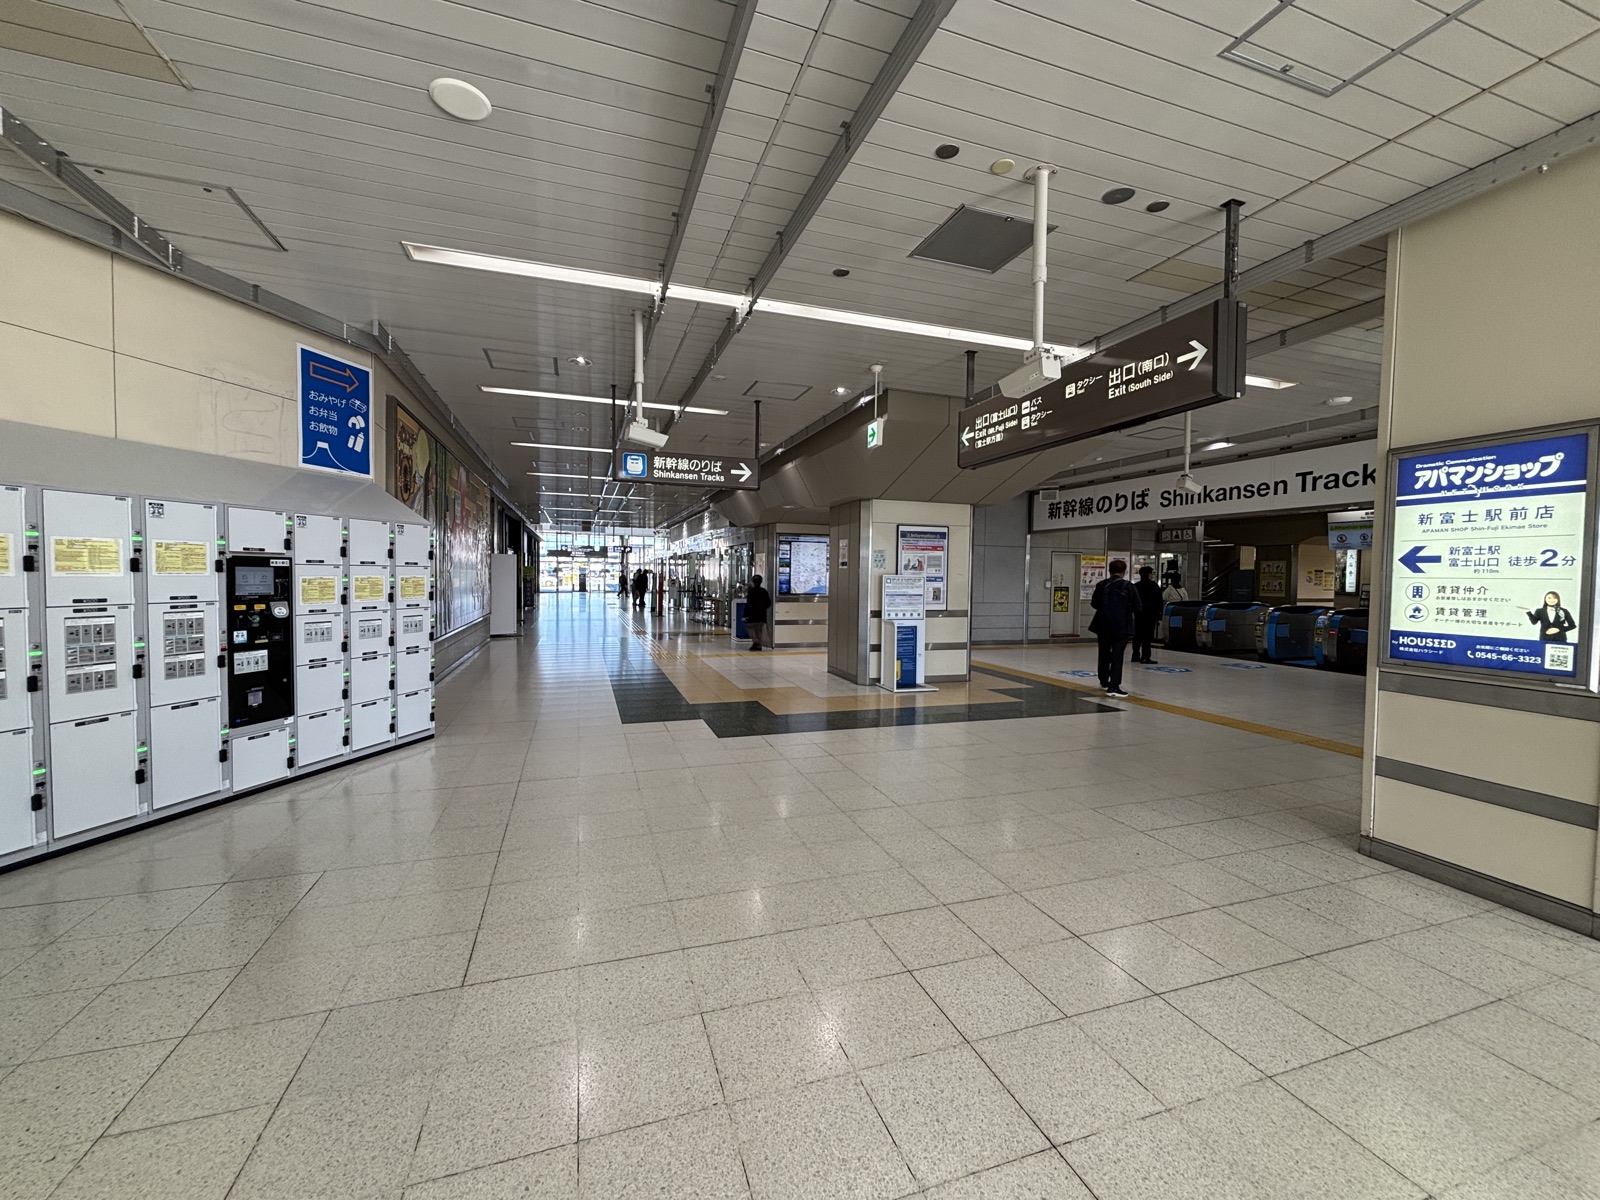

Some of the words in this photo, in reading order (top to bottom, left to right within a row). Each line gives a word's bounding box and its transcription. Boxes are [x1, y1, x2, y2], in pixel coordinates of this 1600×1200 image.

[1108, 352, 1170, 387] 出口(南口)
[1076, 375, 1103, 389] タクシー
[1108, 385, 1127, 399] Exit
[1128, 378, 1152, 393] (South
[1153, 370, 1174, 385] Side)
[308, 390, 346, 408] おみやげ
[1031, 396, 1042, 406] バス
[308, 406, 338, 421] お弁当
[1031, 410, 1053, 421] タクシー
[309, 420, 338, 436] お飲物
[975, 428, 987, 440] Exit
[653, 456, 722, 472] 新幹線のりば
[1413, 452, 1565, 490] アパマンショップ
[653, 469, 698, 480] Shinkansen
[700, 472, 725, 482] Tracks
[1159, 478, 1289, 508] Shinkansen
[1048, 487, 1150, 520] 新幹線のりば
[1417, 505, 1555, 526] 新富士駅前店
[1448, 545, 1501, 556] 新富士駅
[1448, 557, 1500, 568] 富士山口
[1508, 549, 1577, 568] 徒歩2分
[1437, 585, 1488, 596] 賃貸仲介
[1435, 607, 1488, 618] 賃貸管理
[1475, 651, 1542, 664] 0545-66-3323
